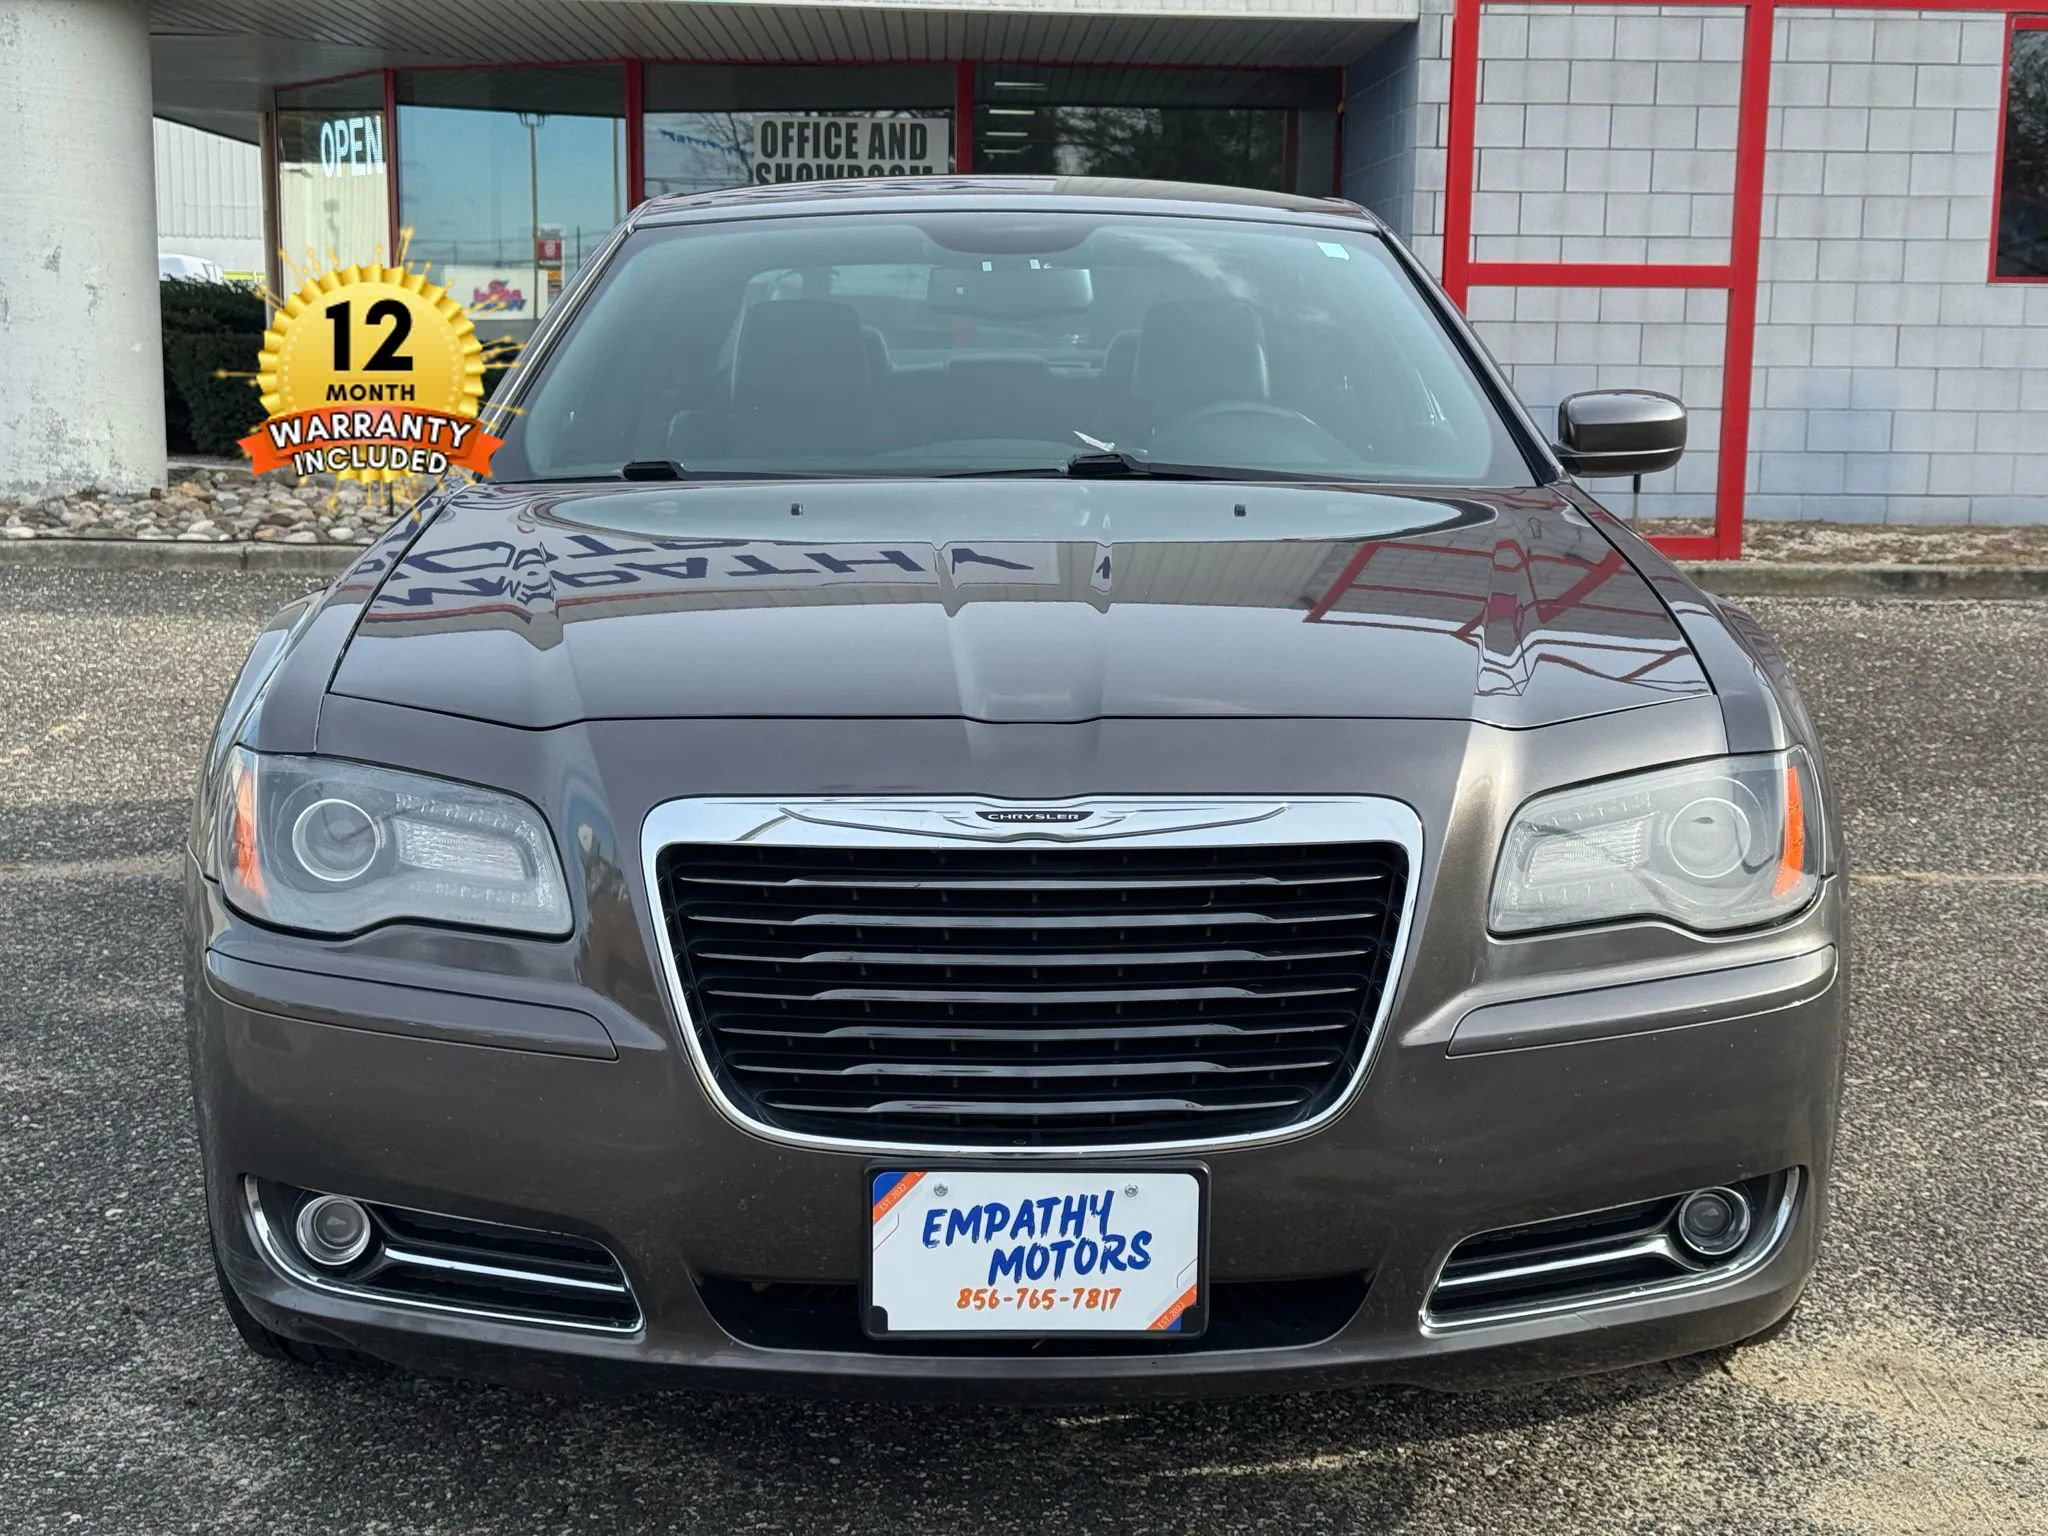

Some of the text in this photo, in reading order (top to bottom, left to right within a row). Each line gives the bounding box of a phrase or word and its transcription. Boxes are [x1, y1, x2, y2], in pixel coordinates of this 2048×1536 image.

[320, 115, 383, 178] OPEN
[761, 121, 927, 161] OFFICE AND
[922, 1190, 1115, 1248] EMPATHY
[988, 1231, 1153, 1286] MOTORS
[956, 1288, 1122, 1312] 856-765-7817
